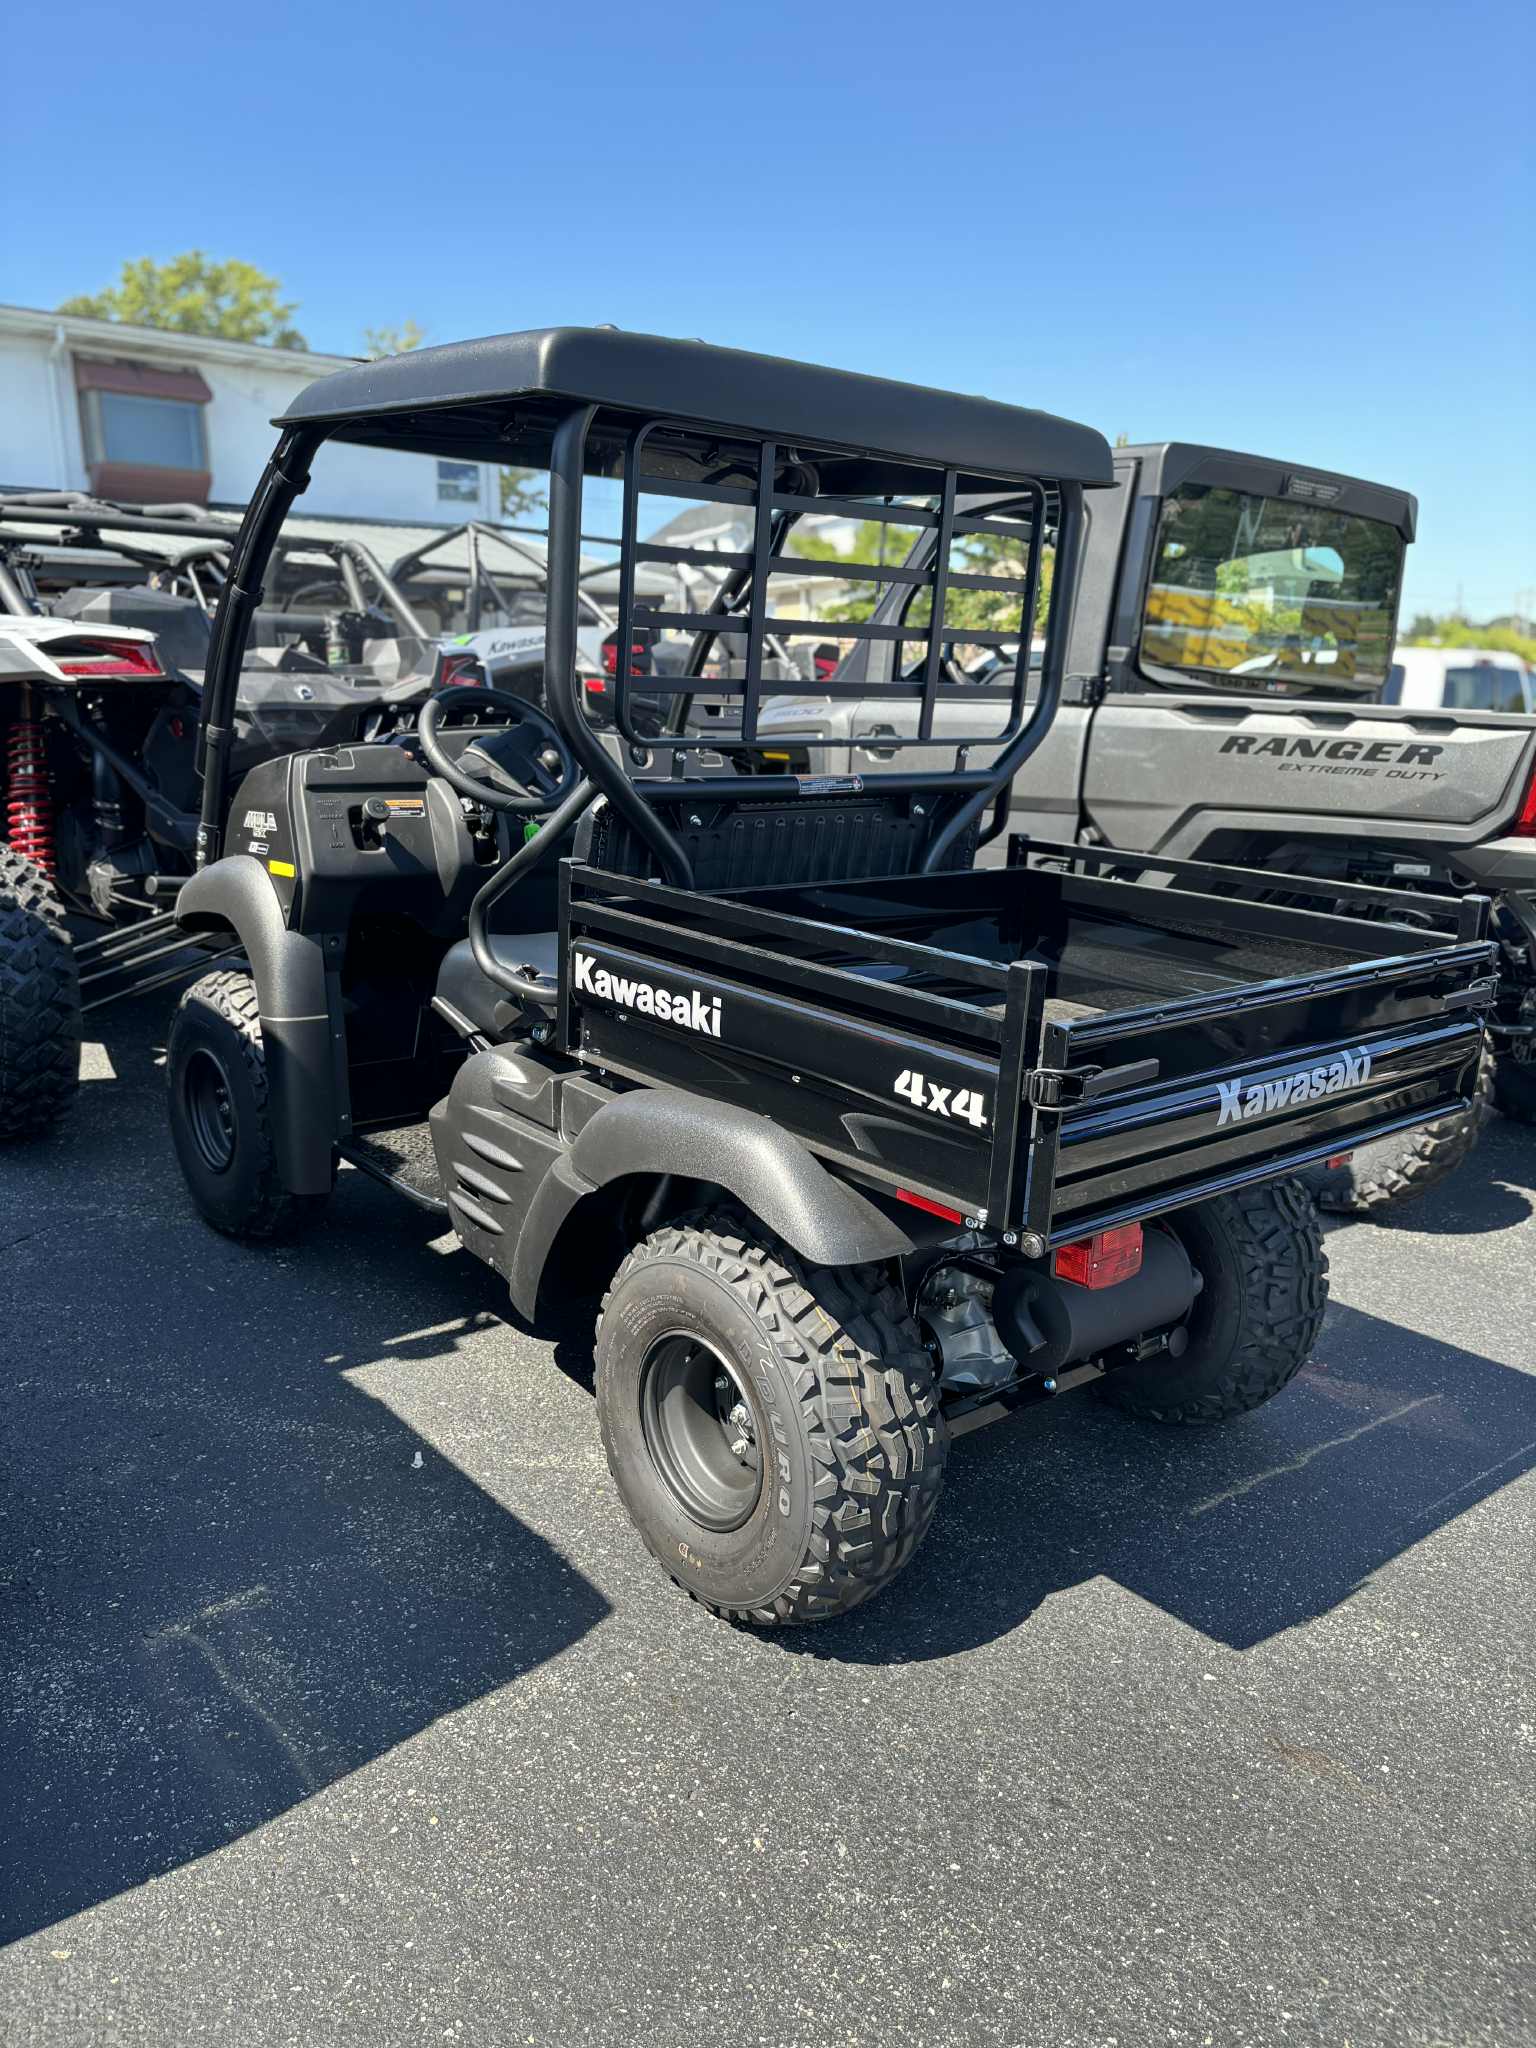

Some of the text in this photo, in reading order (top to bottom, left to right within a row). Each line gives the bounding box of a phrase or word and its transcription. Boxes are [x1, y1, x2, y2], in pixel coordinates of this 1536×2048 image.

[489, 636, 547, 654] Kawasa
[1218, 736, 1444, 765] RANGER
[1278, 763, 1447, 781] EXTREME DUTY
[575, 952, 722, 1037] Kawasaki
[894, 1069, 987, 1128] 4x4
[1216, 1045, 1371, 1127] Kawasaki
